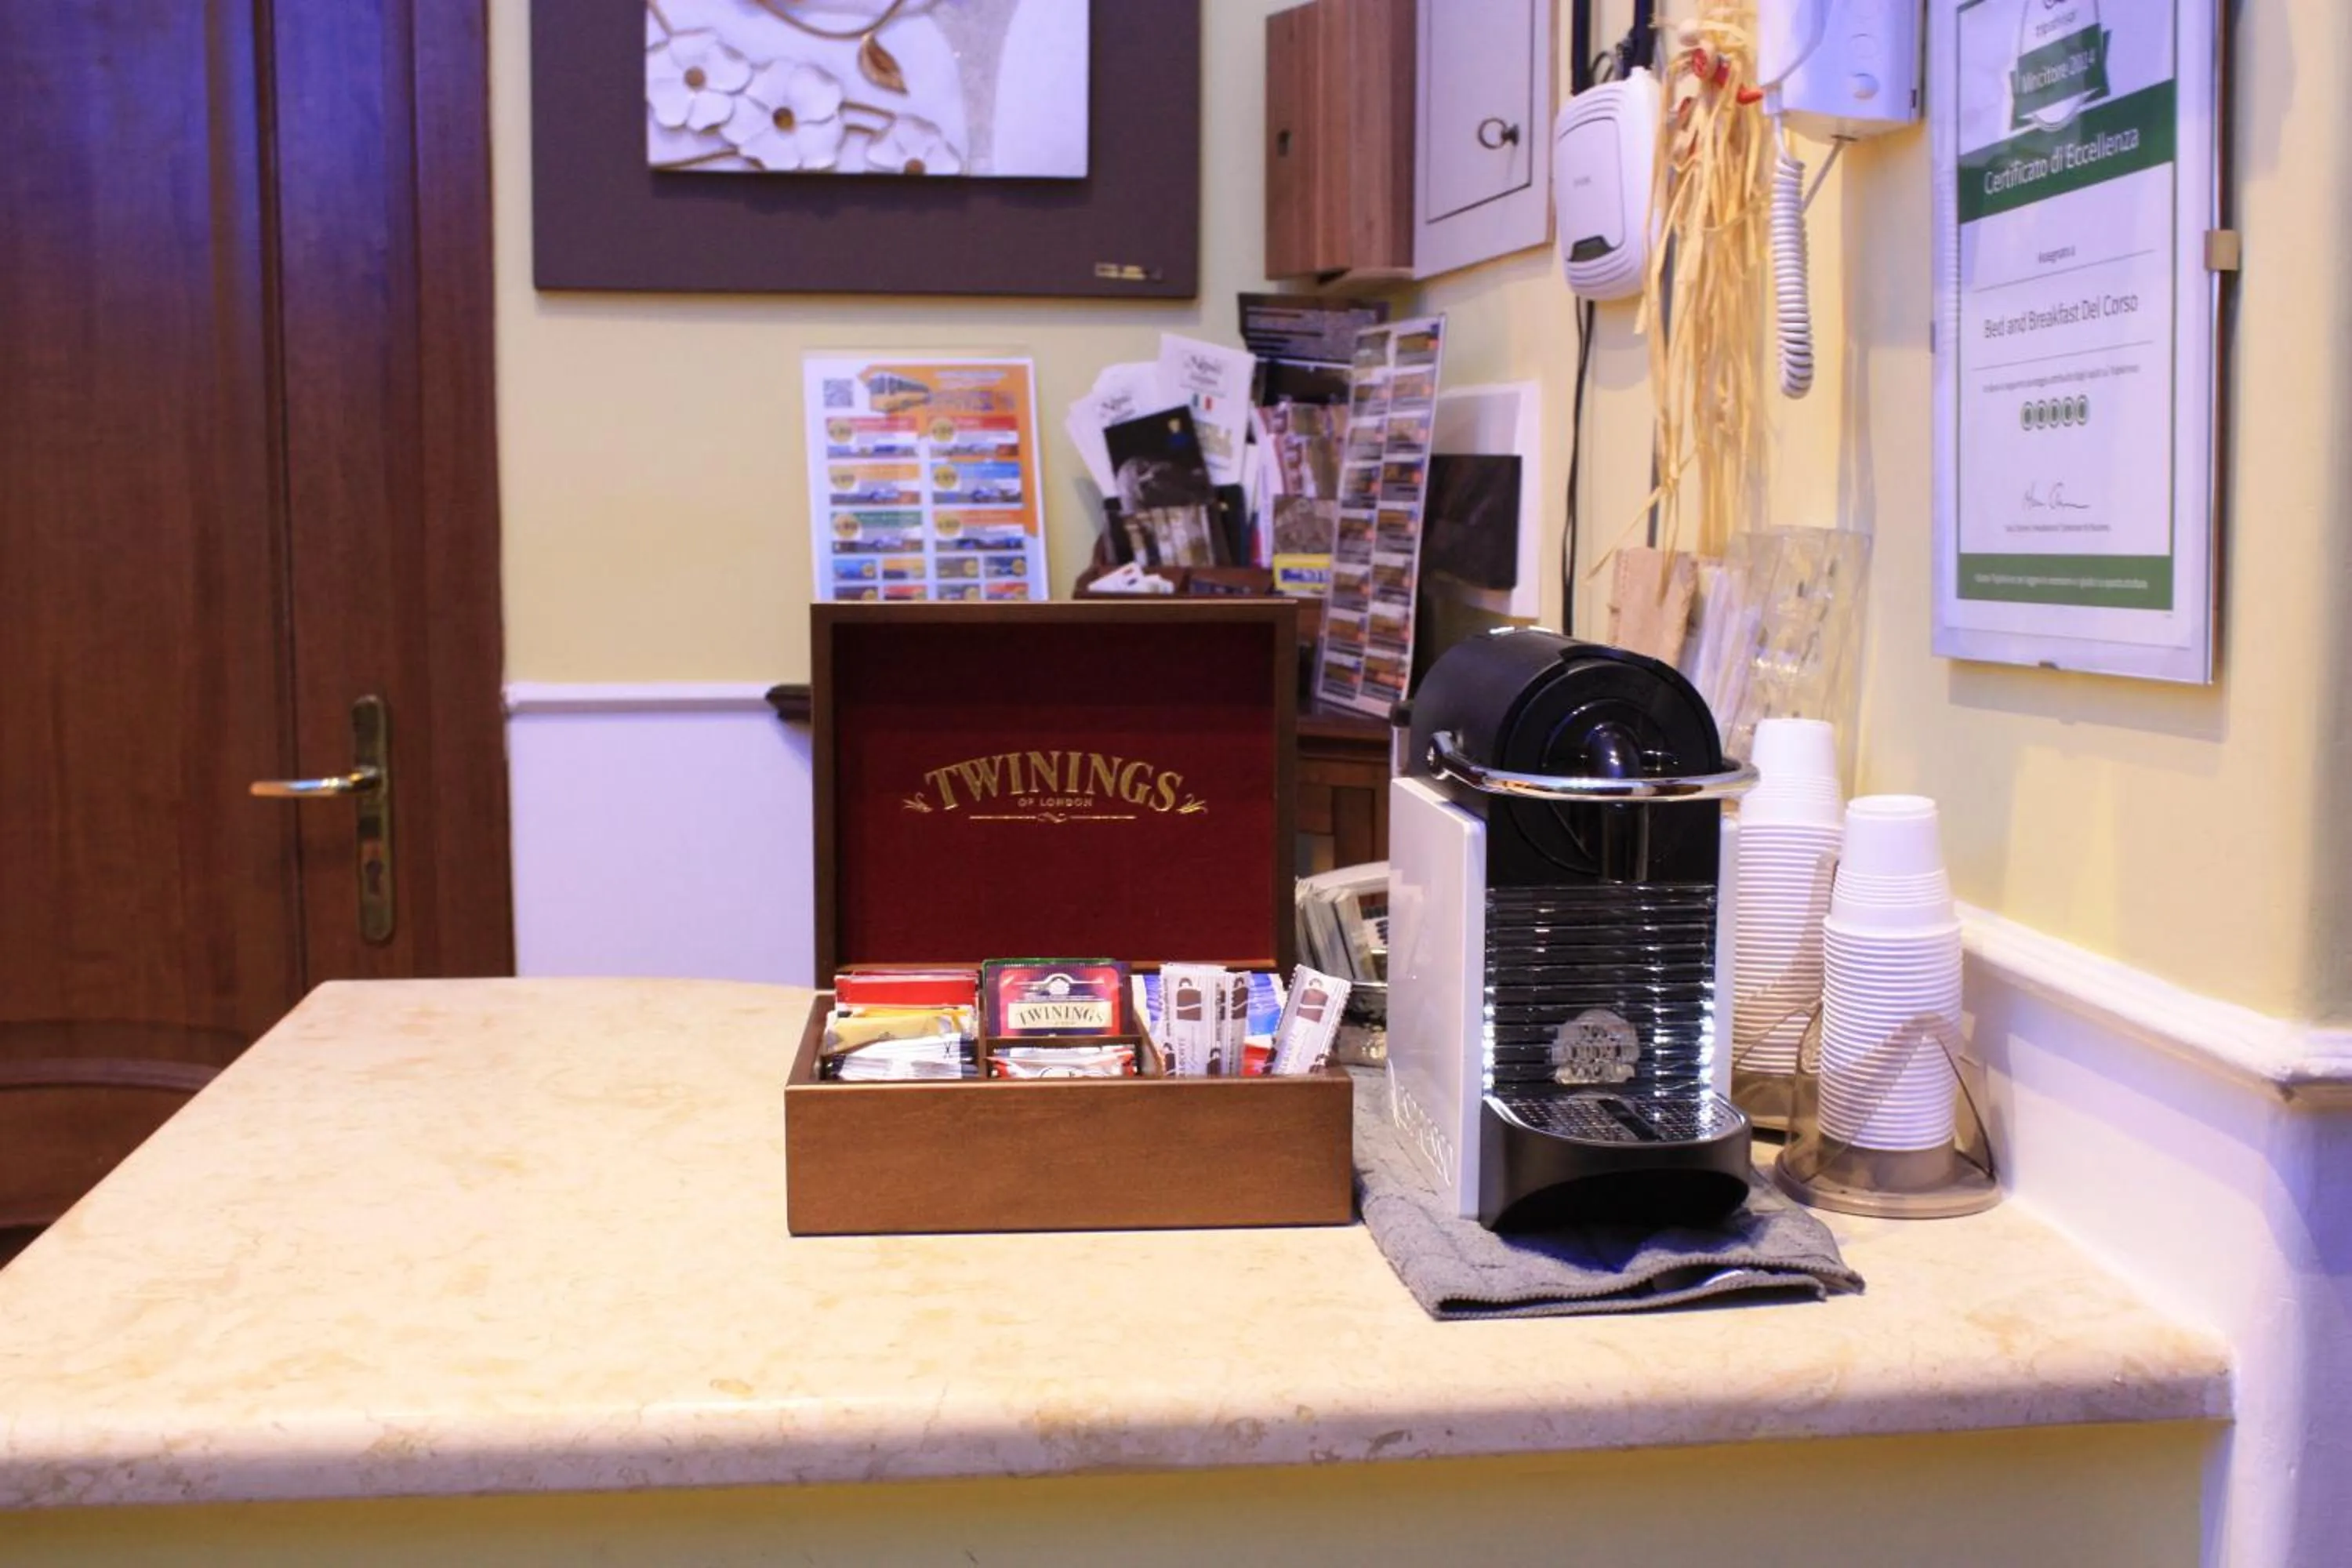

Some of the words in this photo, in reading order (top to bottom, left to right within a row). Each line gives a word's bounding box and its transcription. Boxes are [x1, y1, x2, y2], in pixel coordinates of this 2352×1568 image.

[1984, 159, 2048, 195] Certificato
[2050, 144, 2063, 174] di
[2065, 128, 2140, 169] Eccellenza
[1984, 315, 2005, 339] Bed
[2006, 312, 2027, 335] and
[2028, 303, 2080, 331] Breakfast
[2082, 295, 2100, 321] Del
[2103, 294, 2139, 317] Corso
[924, 750, 1184, 811] TWININGS
[1018, 797, 1035, 808] OF
[1039, 797, 1093, 808] LONDON
[1016, 1004, 1105, 1026] TWININGS
